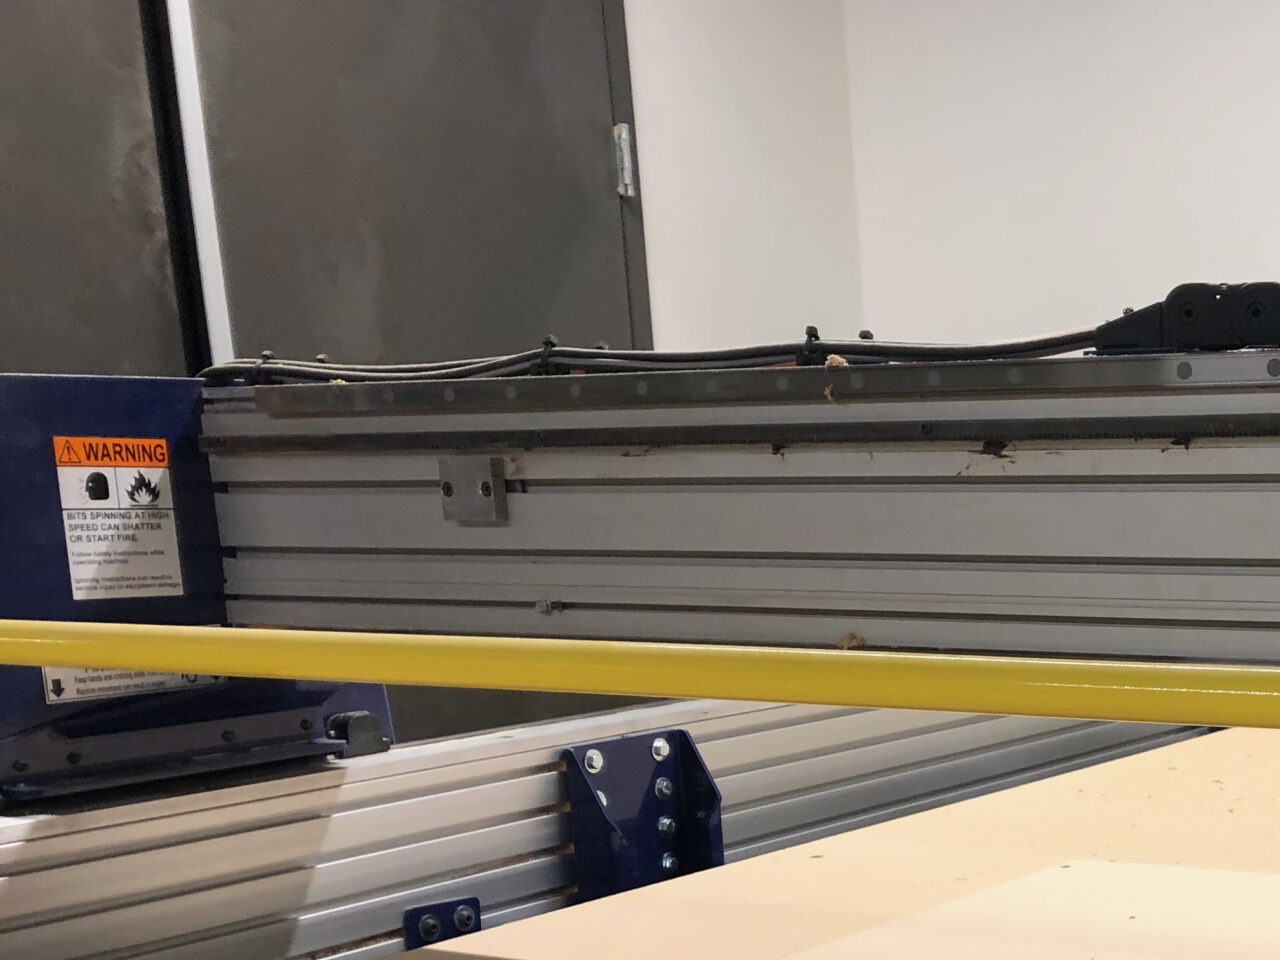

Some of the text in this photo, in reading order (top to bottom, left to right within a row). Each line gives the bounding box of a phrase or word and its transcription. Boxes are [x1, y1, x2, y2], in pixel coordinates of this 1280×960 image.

[82, 442, 166, 463] WARNING
[66, 511, 170, 520] BITS SPINNING AT HIGH
[68, 522, 163, 532] SPEED CAN SHATTER
[69, 534, 83, 543] OR
[85, 534, 115, 542] START
